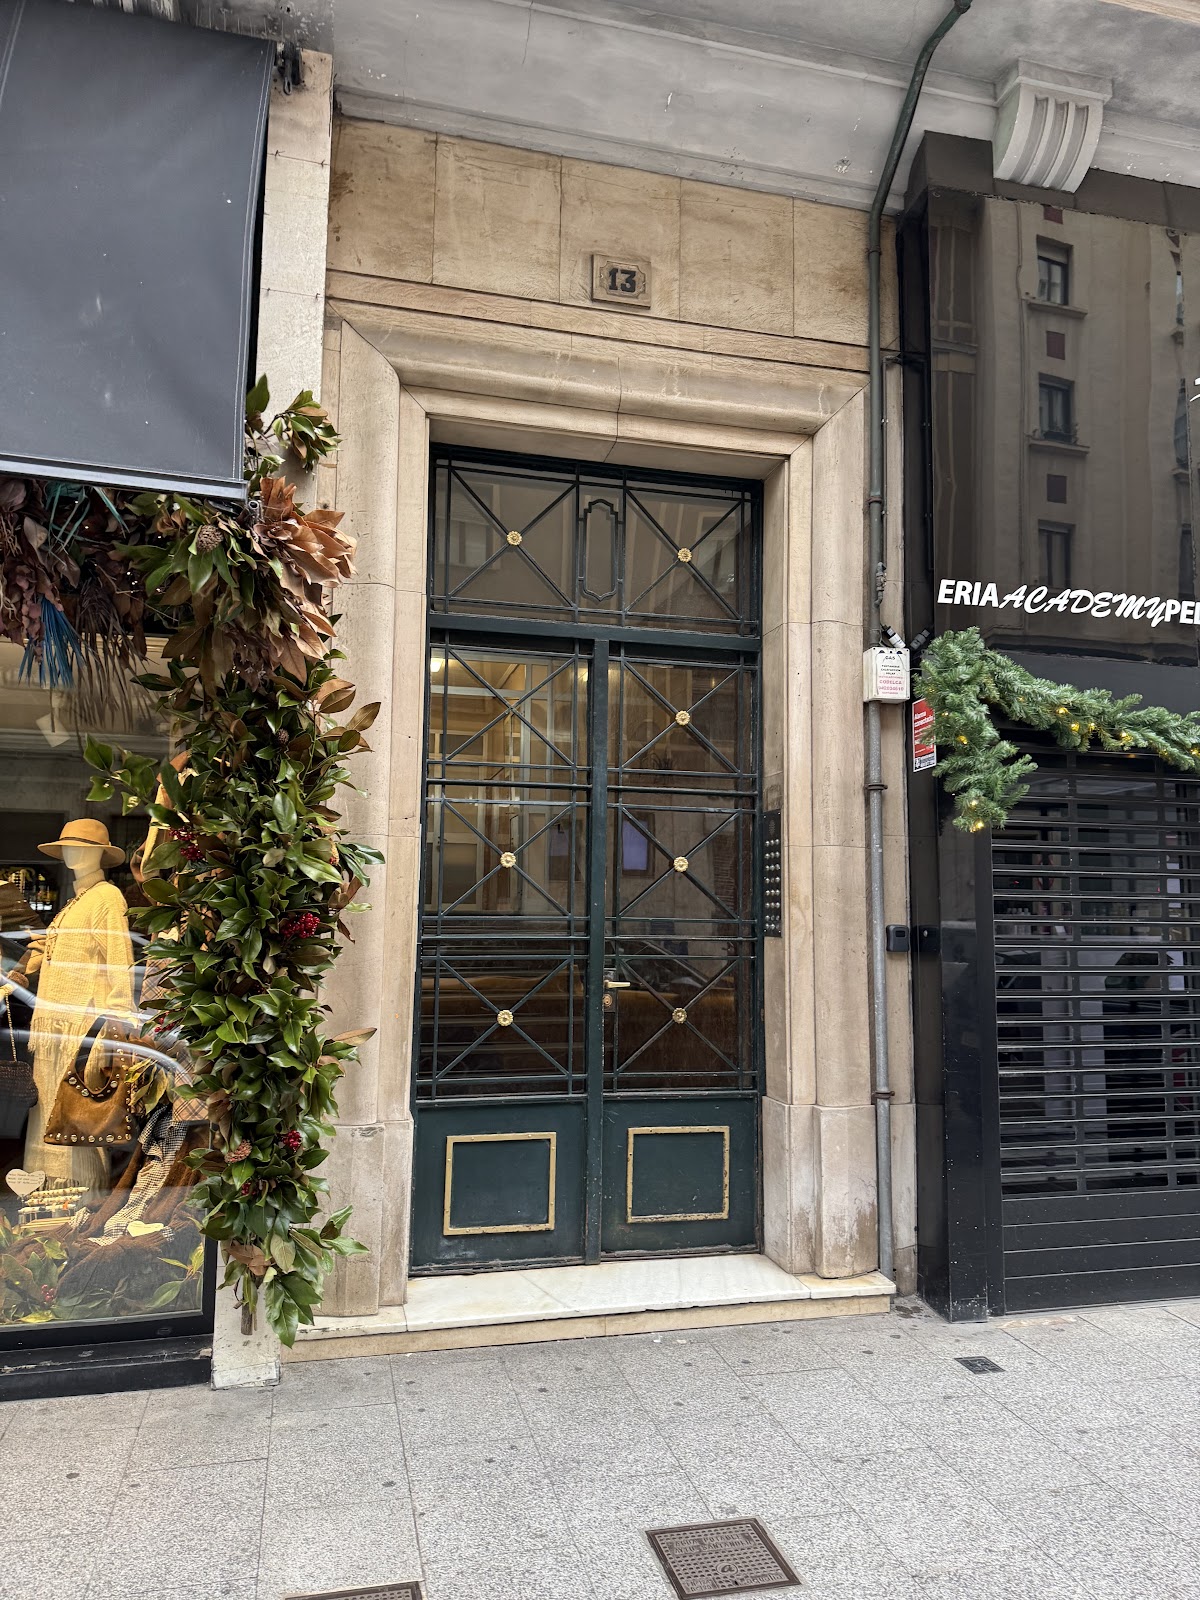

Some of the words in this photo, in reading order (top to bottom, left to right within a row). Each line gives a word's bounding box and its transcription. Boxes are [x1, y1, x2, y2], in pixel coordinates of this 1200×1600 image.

[608, 267, 637, 293] 13
[937, 579, 999, 608] ERIA
[999, 584, 1167, 628] ACADEMY
